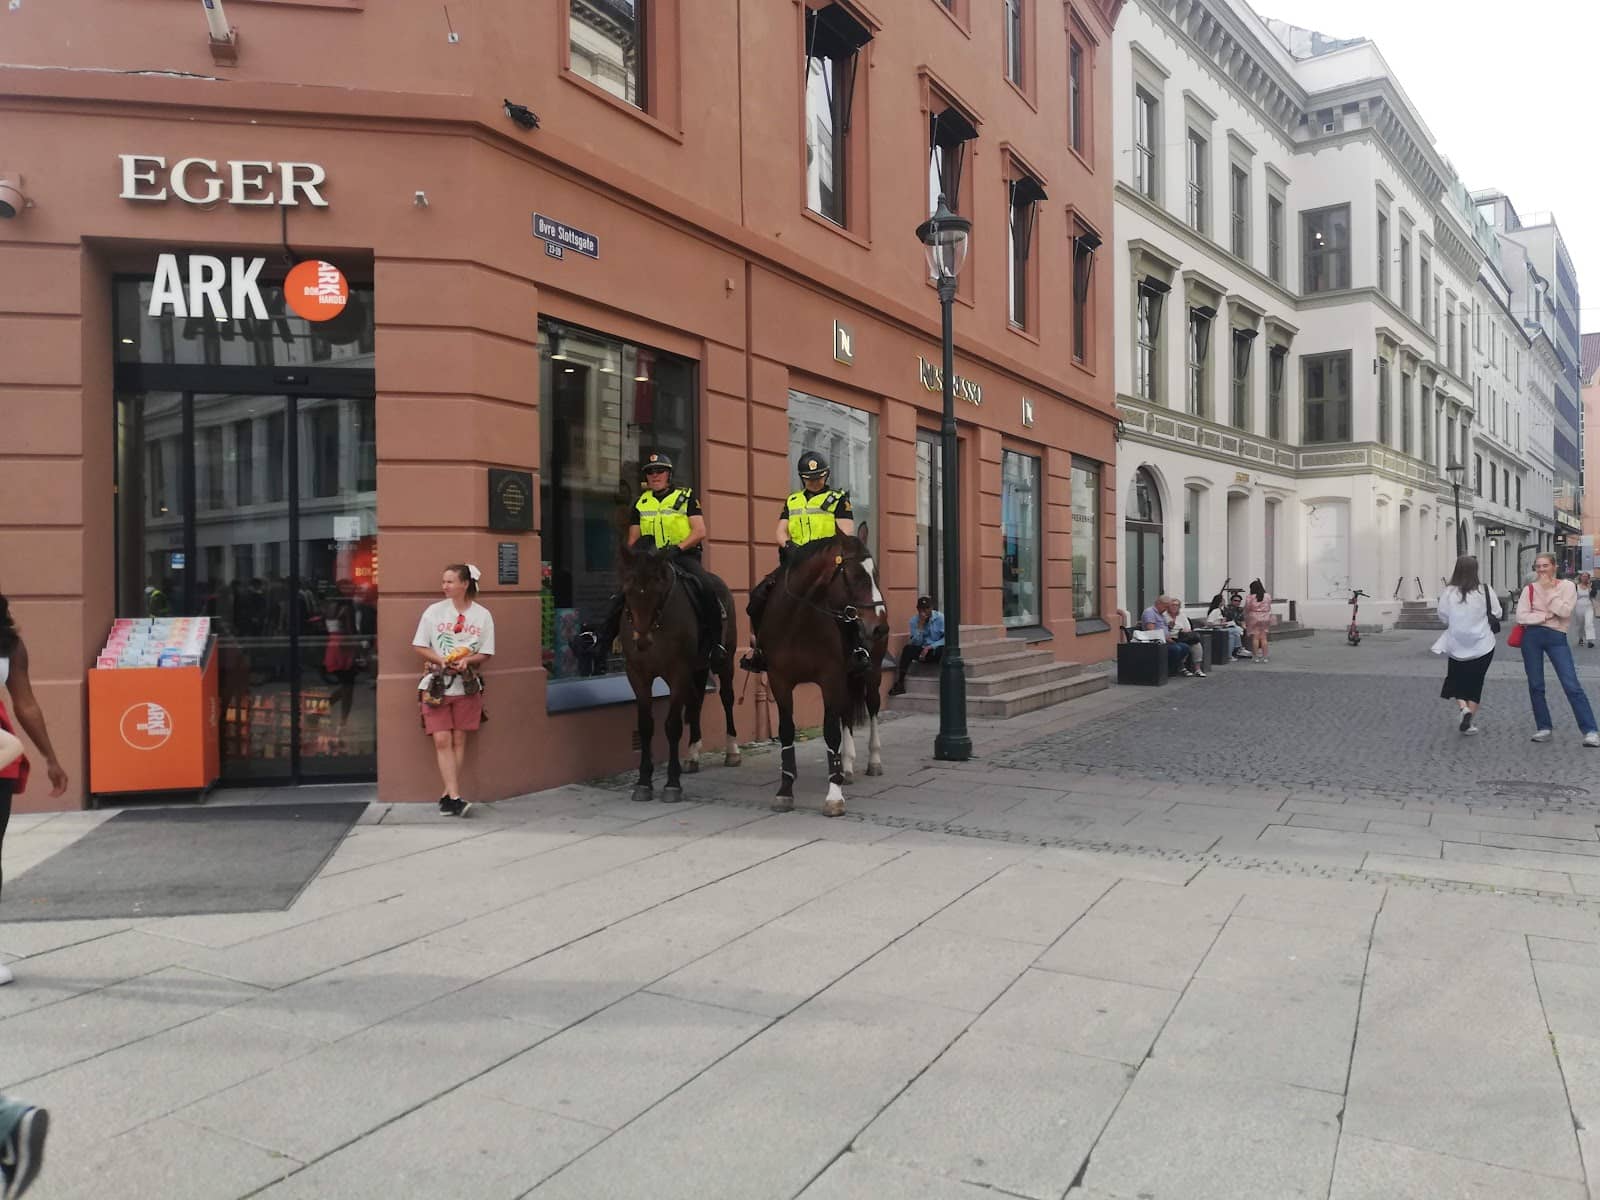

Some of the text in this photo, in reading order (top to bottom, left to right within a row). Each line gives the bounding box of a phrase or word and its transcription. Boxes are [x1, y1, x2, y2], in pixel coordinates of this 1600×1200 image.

[118, 154, 329, 206] EGER
[539, 219, 595, 251] Øvre Slottsgate
[148, 253, 270, 320] ARK
[318, 260, 341, 296] ARK
[436, 622, 481, 638] ORNGE
